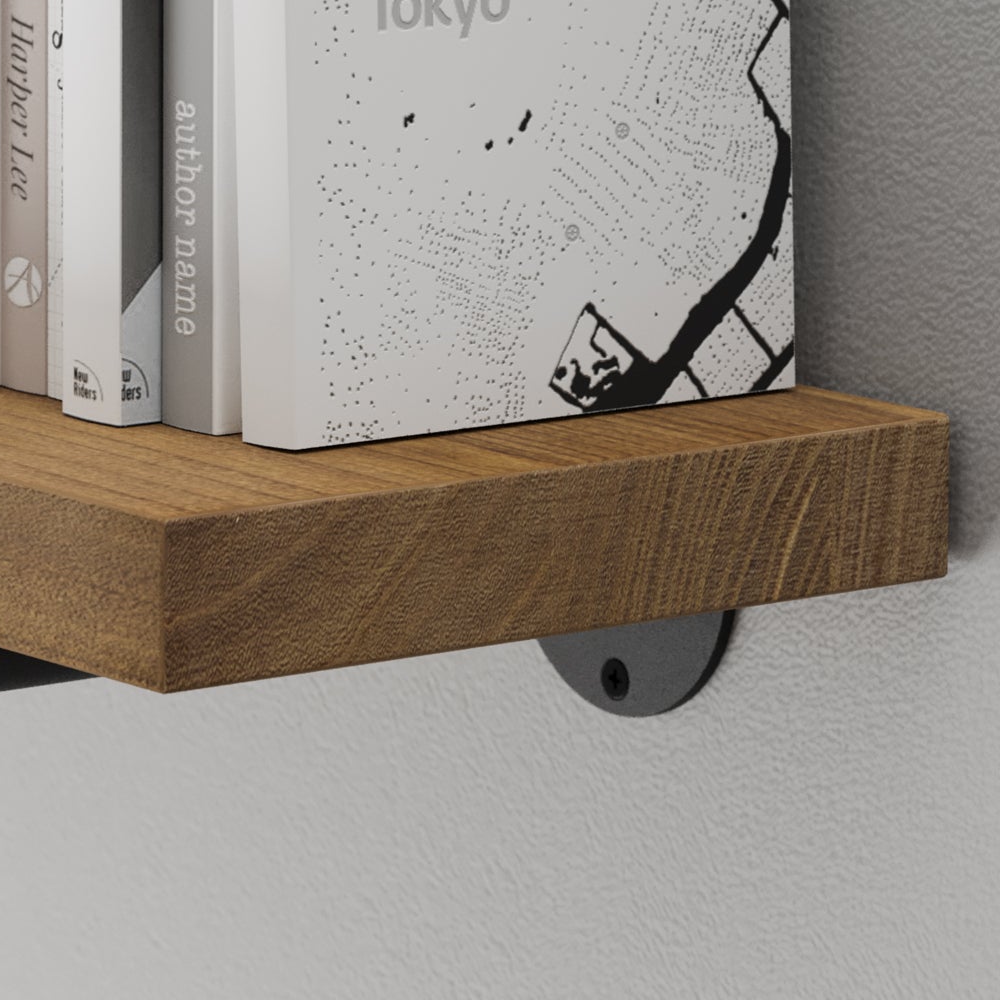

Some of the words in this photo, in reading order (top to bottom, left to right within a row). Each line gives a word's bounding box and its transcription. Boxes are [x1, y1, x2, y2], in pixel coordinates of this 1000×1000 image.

[7, 14, 35, 138] Harper
[10, 144, 35, 202] Lee
[174, 99, 202, 227] author
[174, 235, 197, 336] name
[73, 366, 89, 384] New
[73, 381, 97, 401] Riders
[121, 384, 142, 402] ders
